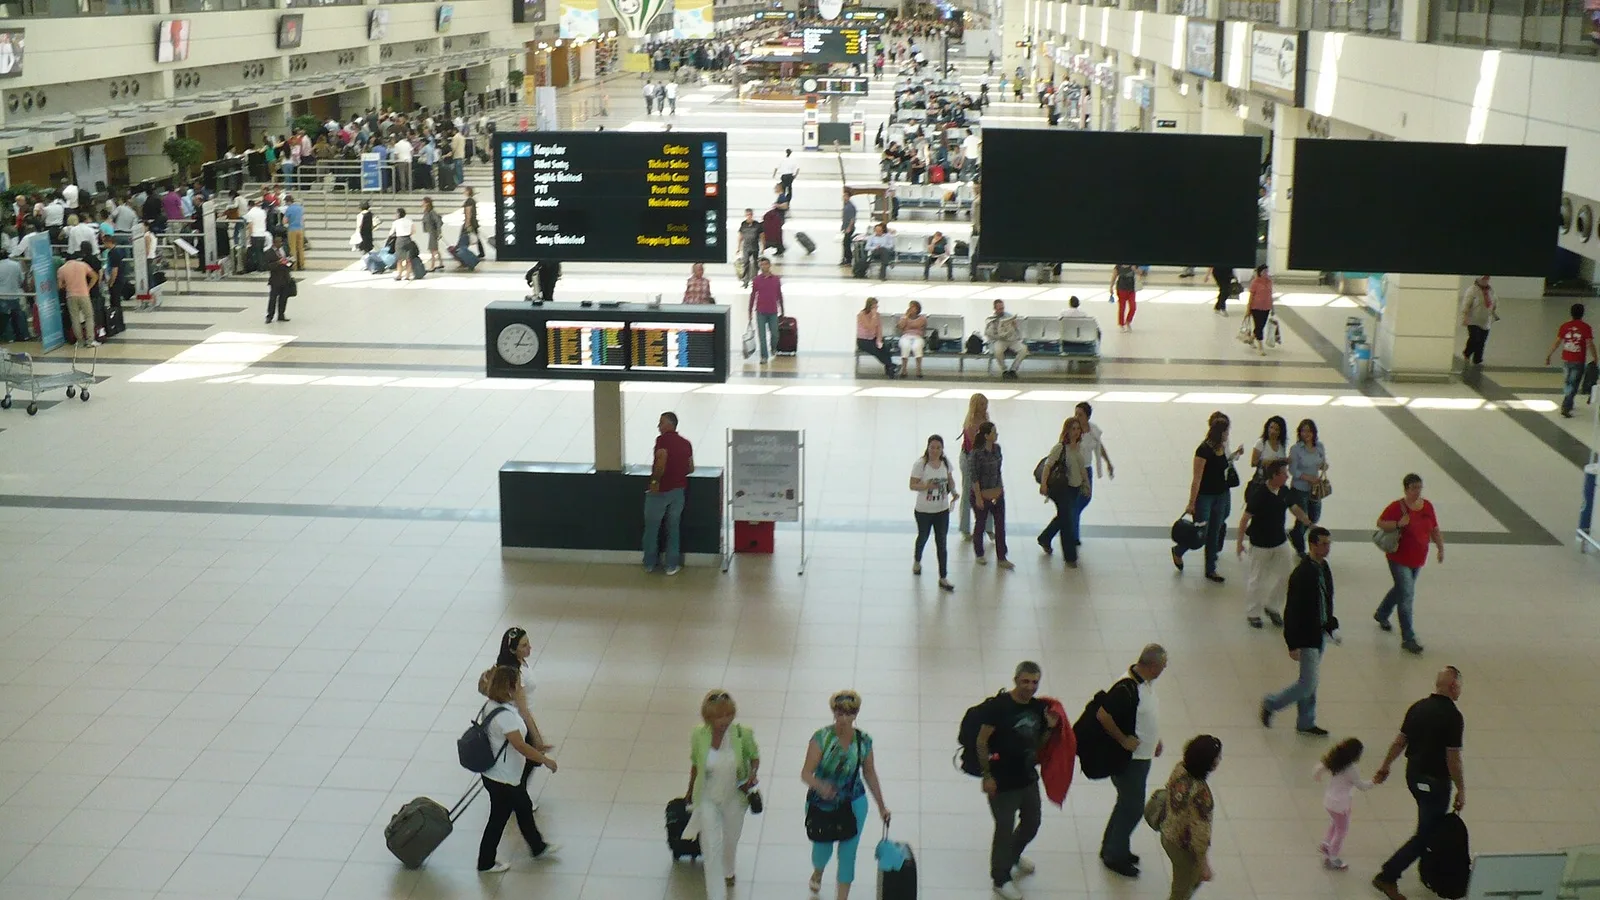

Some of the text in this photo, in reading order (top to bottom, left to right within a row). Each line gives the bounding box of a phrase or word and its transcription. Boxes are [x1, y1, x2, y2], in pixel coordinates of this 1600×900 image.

[663, 144, 690, 154] Gates
[534, 159, 551, 168] Bilet
[648, 159, 690, 168] Ticket Sales
[647, 172, 689, 182] Health Care
[534, 185, 548, 194] PTT
[652, 184, 689, 194] Post Office
[648, 198, 690, 207] Hairdresser
[637, 235, 690, 246] Shopping Units
